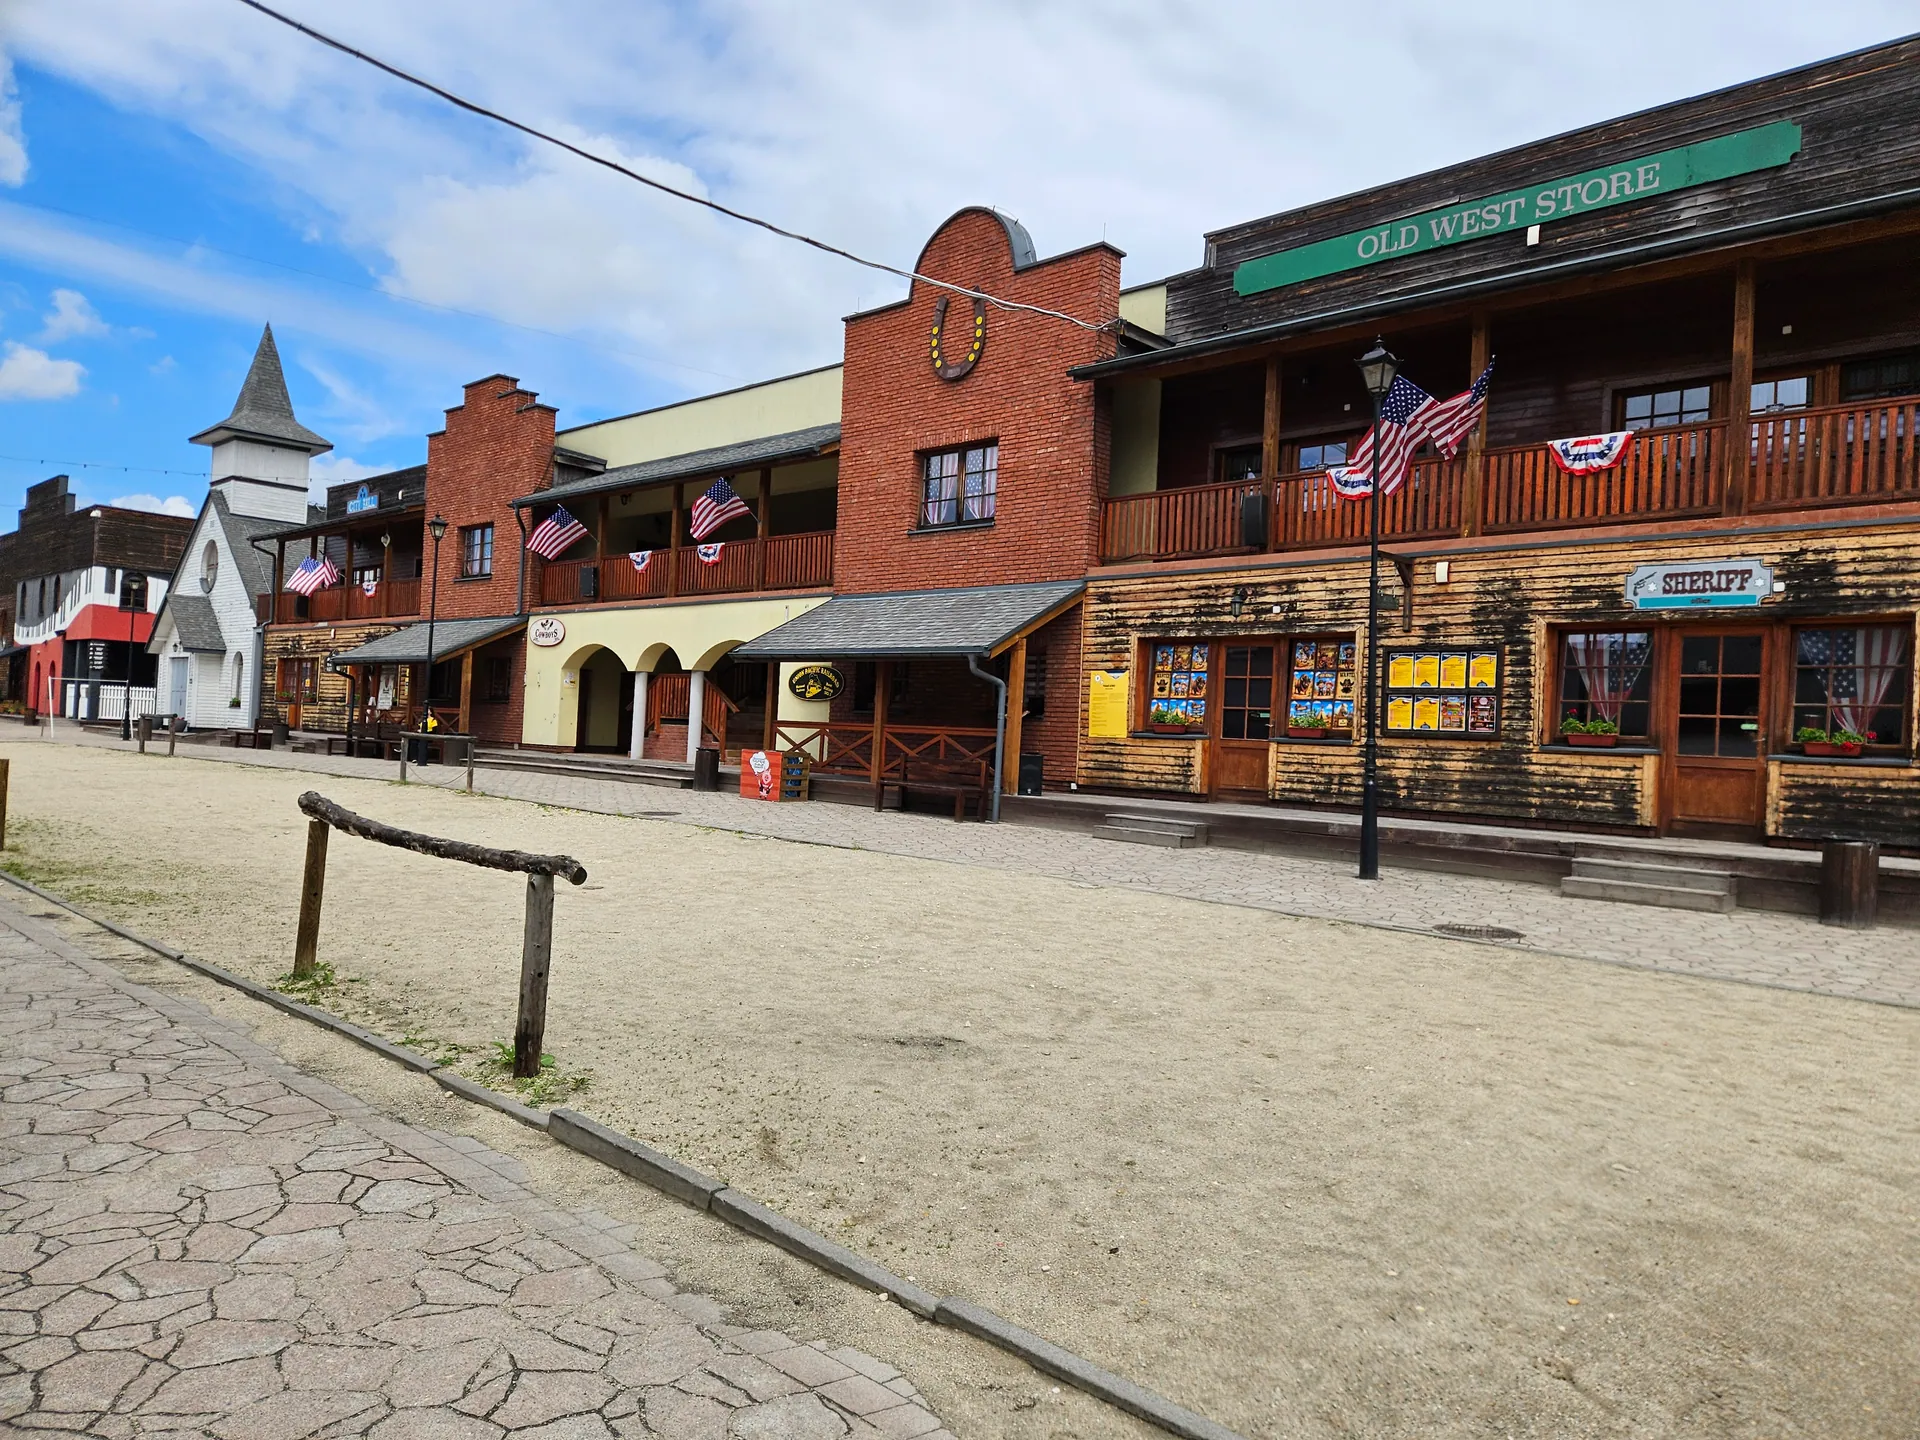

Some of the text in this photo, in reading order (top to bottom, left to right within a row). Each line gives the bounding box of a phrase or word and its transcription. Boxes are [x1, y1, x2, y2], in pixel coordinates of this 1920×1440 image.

[1357, 162, 1661, 259] OLD WEST STORE
[1662, 568, 1753, 595] SHERIFF
